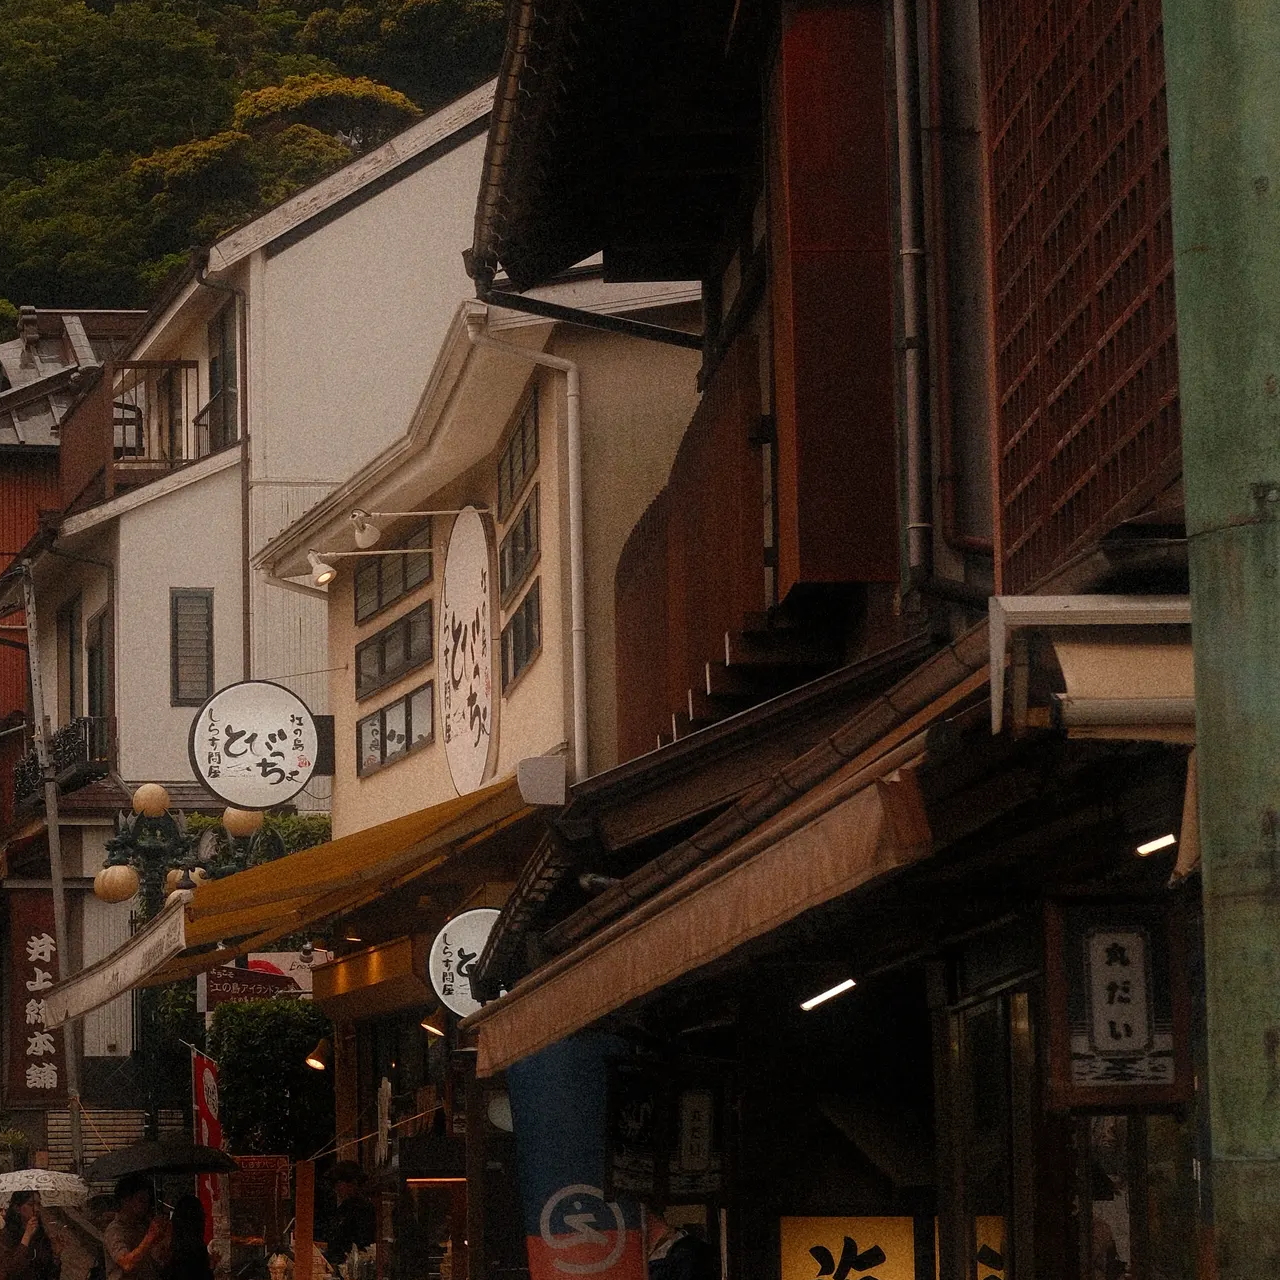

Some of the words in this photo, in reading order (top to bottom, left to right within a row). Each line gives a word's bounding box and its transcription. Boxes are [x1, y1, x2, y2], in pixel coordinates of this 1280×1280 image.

[207, 708, 221, 779] しらす問屋
[289, 713, 305, 752] 江の島
[210, 968, 235, 979] ようこそ
[441, 932, 455, 997] しらす問屋
[1105, 942, 1133, 1040] 丸だい
